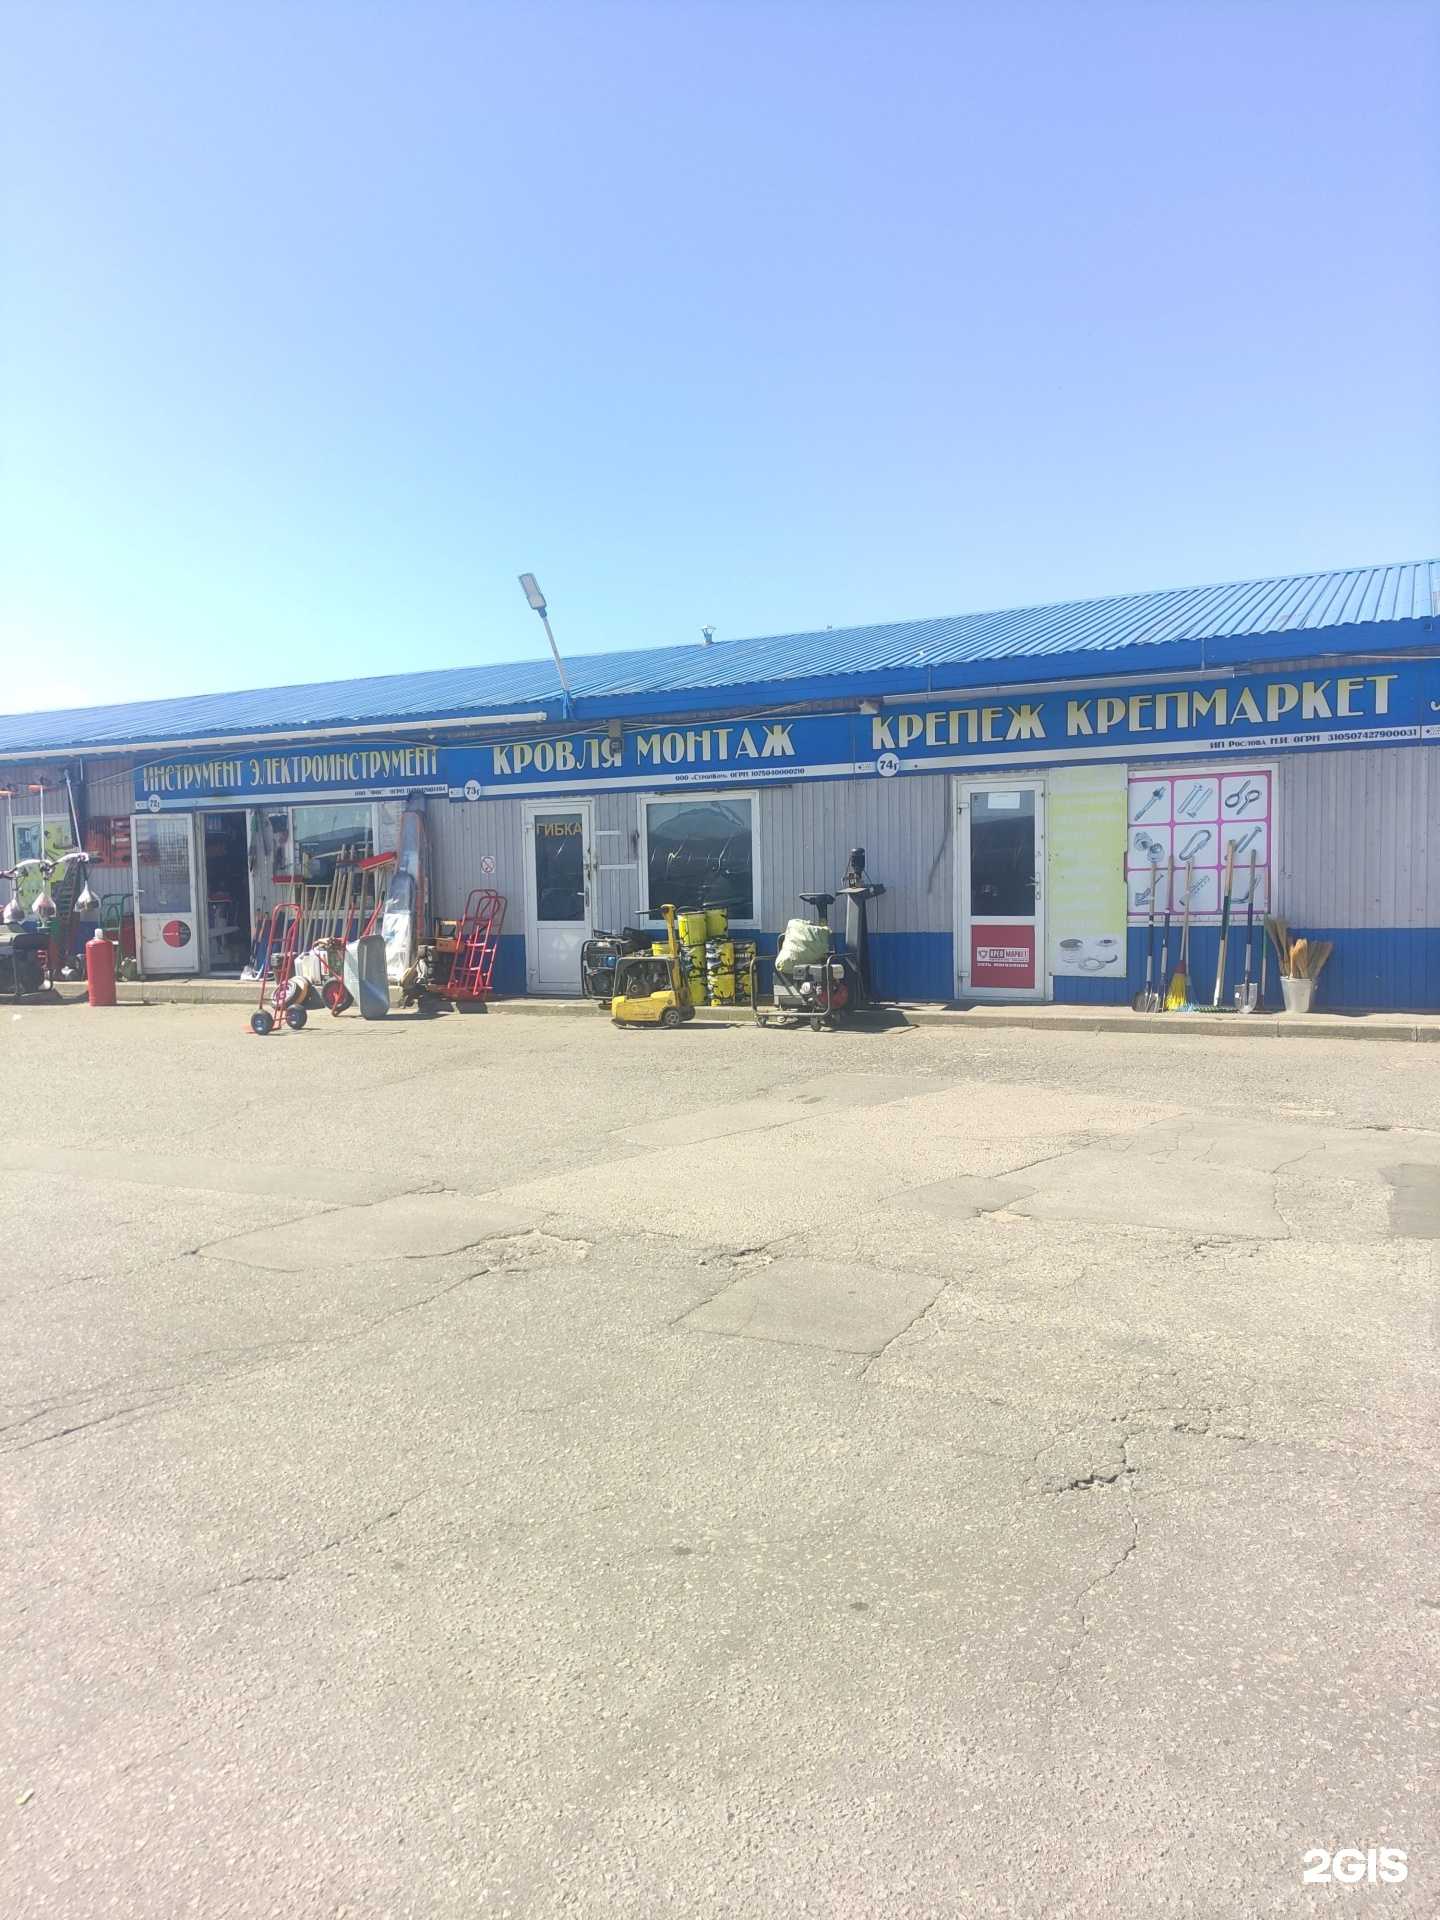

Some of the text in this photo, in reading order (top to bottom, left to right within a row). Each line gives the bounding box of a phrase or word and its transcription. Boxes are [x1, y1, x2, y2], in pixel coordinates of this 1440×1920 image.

[871, 674, 1399, 750] КРЕПЕЖ КРЕПМАРКЕТ
[143, 747, 438, 792] ИНСТРУМЕНТ ЭЛЕКТРОИНСТРУМЕНТ
[493, 723, 796, 775] КРОВЛЯ МОНТАЖ
[536, 822, 583, 837] ГИБКА
